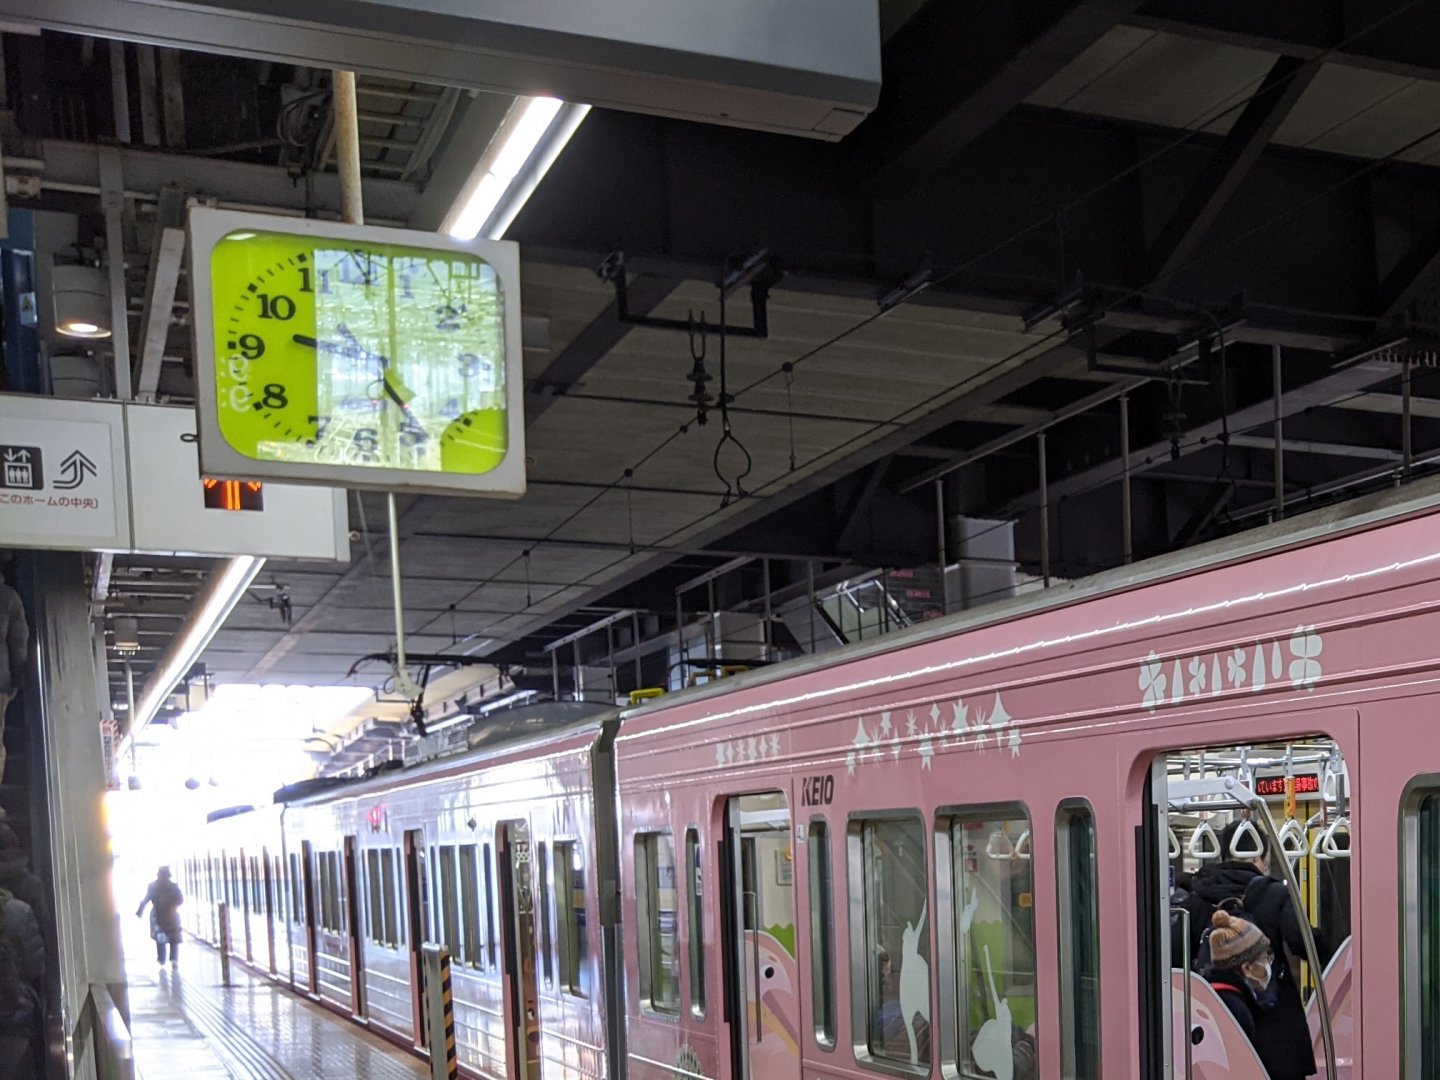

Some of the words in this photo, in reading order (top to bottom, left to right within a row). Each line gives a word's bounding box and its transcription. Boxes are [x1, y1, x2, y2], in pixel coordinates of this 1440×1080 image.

[298, 267, 333, 295] 11
[256, 294, 297, 321] 10
[435, 303, 467, 331] 2
[238, 334, 266, 360] 9
[261, 383, 289, 409] 8
[307, 415, 332, 448] 7
[354, 428, 378, 452] 6
[802, 775, 834, 806] KEIO
